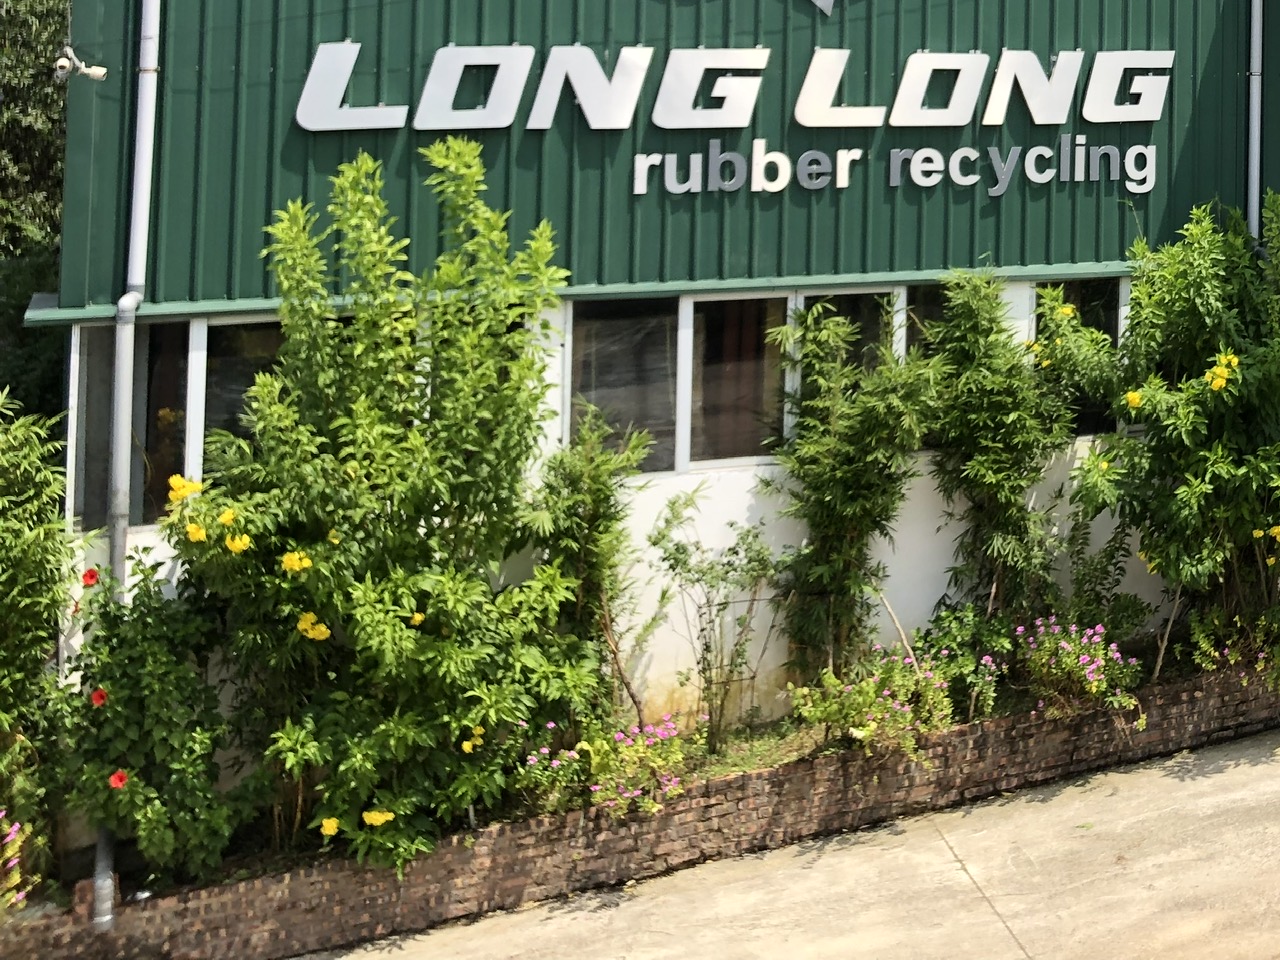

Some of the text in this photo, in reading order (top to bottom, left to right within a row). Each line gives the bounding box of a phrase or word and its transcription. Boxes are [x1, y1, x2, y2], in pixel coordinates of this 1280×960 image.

[296, 42, 1176, 131] LONG LONG
[633, 134, 1157, 196] rubber recycling
